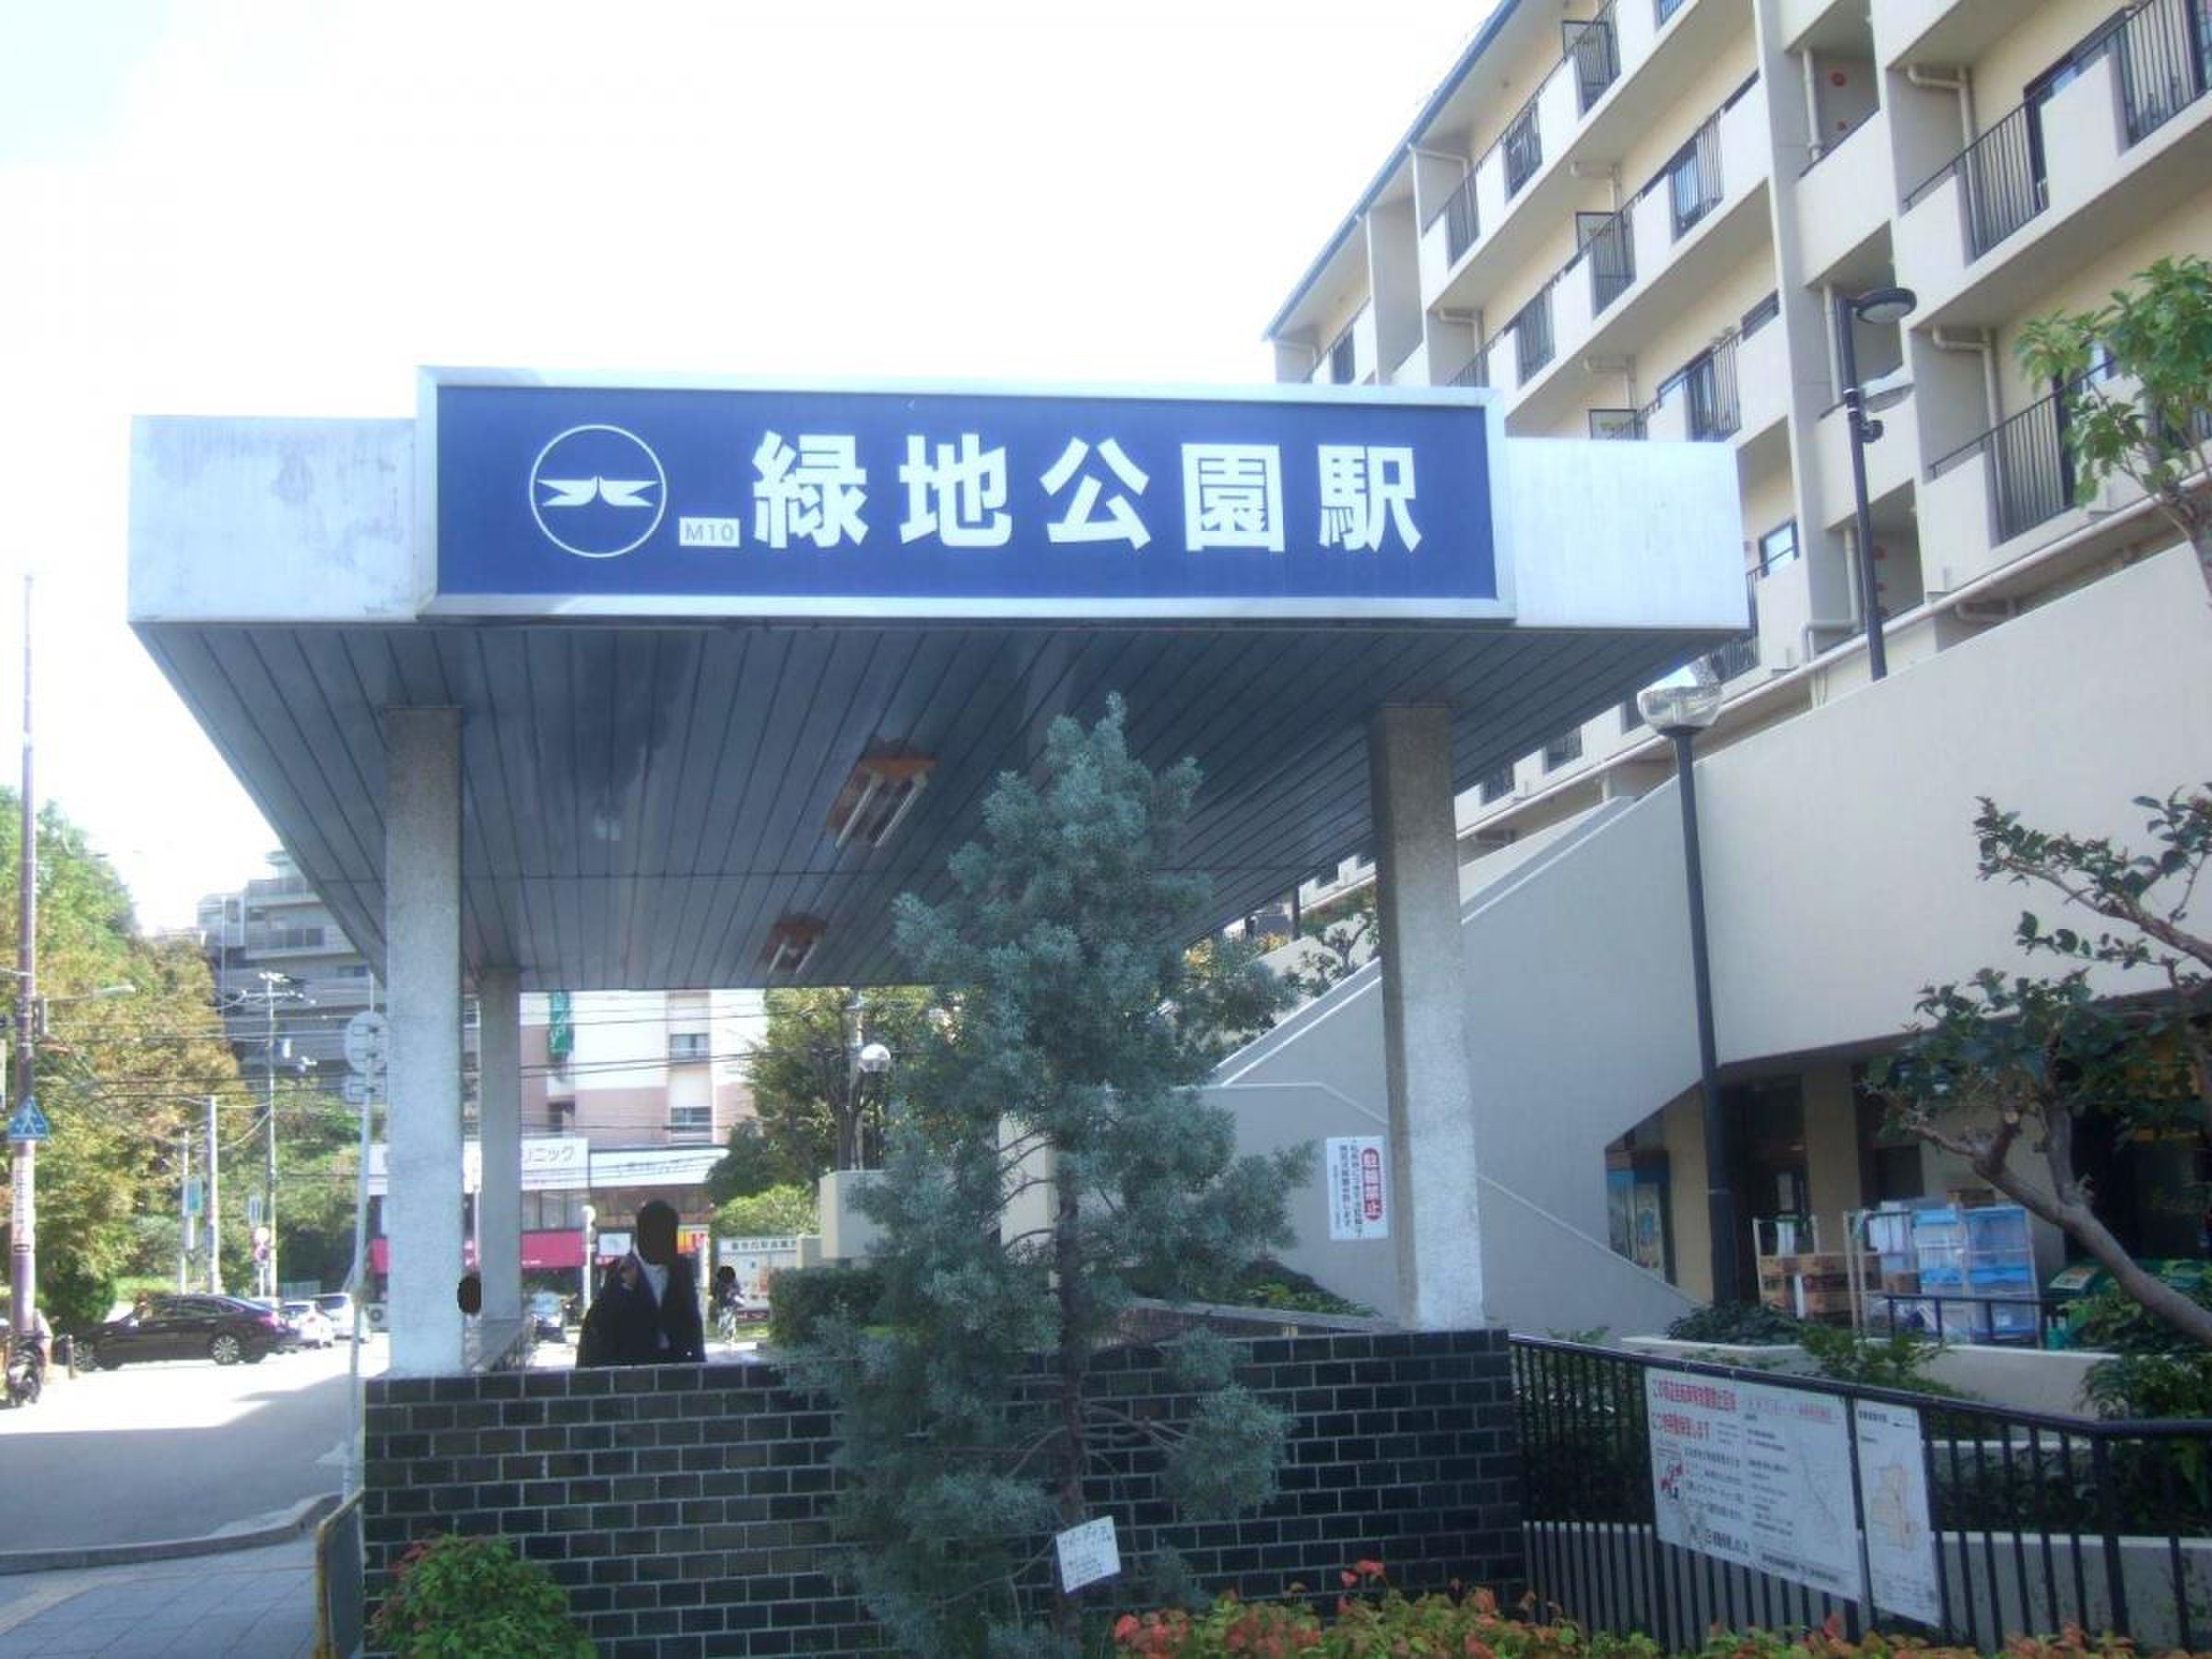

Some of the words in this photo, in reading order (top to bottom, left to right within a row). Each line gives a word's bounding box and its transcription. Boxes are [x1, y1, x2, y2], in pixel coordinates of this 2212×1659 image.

[752, 430, 1421, 552] 緑地公園駅
[685, 524, 735, 542] M10
